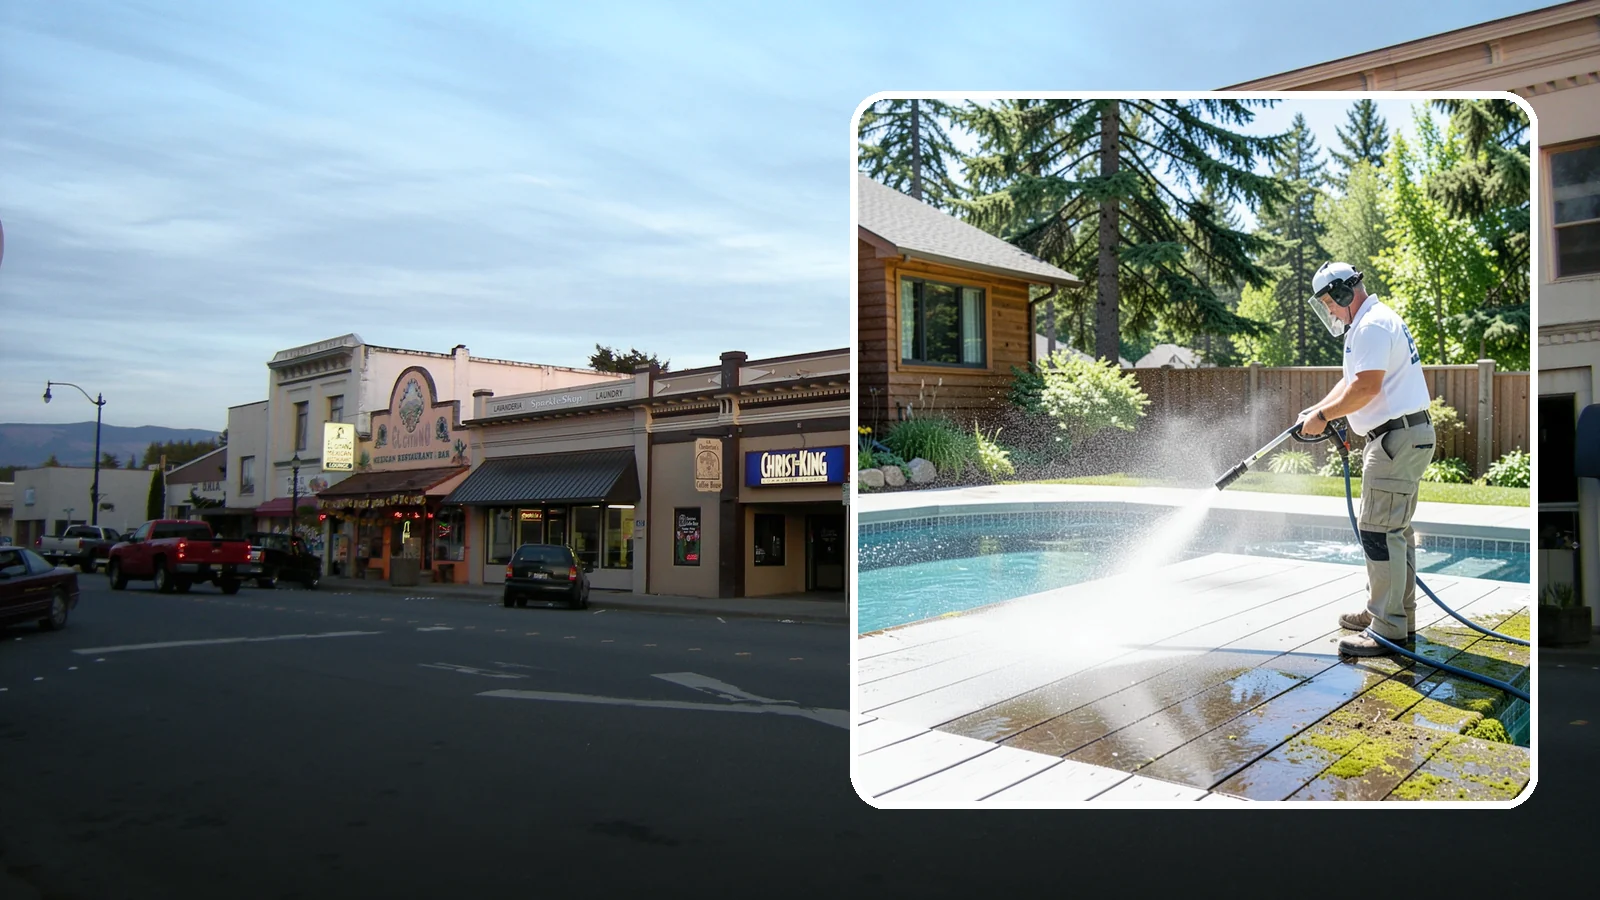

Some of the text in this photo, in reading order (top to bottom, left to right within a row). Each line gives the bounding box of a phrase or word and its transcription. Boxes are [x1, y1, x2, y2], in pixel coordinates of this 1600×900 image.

[595, 388, 623, 400] LAUNDRY
[493, 402, 523, 413] LAVANDERIA
[531, 394, 582, 409] Sparkle Shop
[397, 451, 433, 462] RESTAURANT
[437, 450, 450, 459] BAR
[761, 450, 828, 478] CHRIST KING
